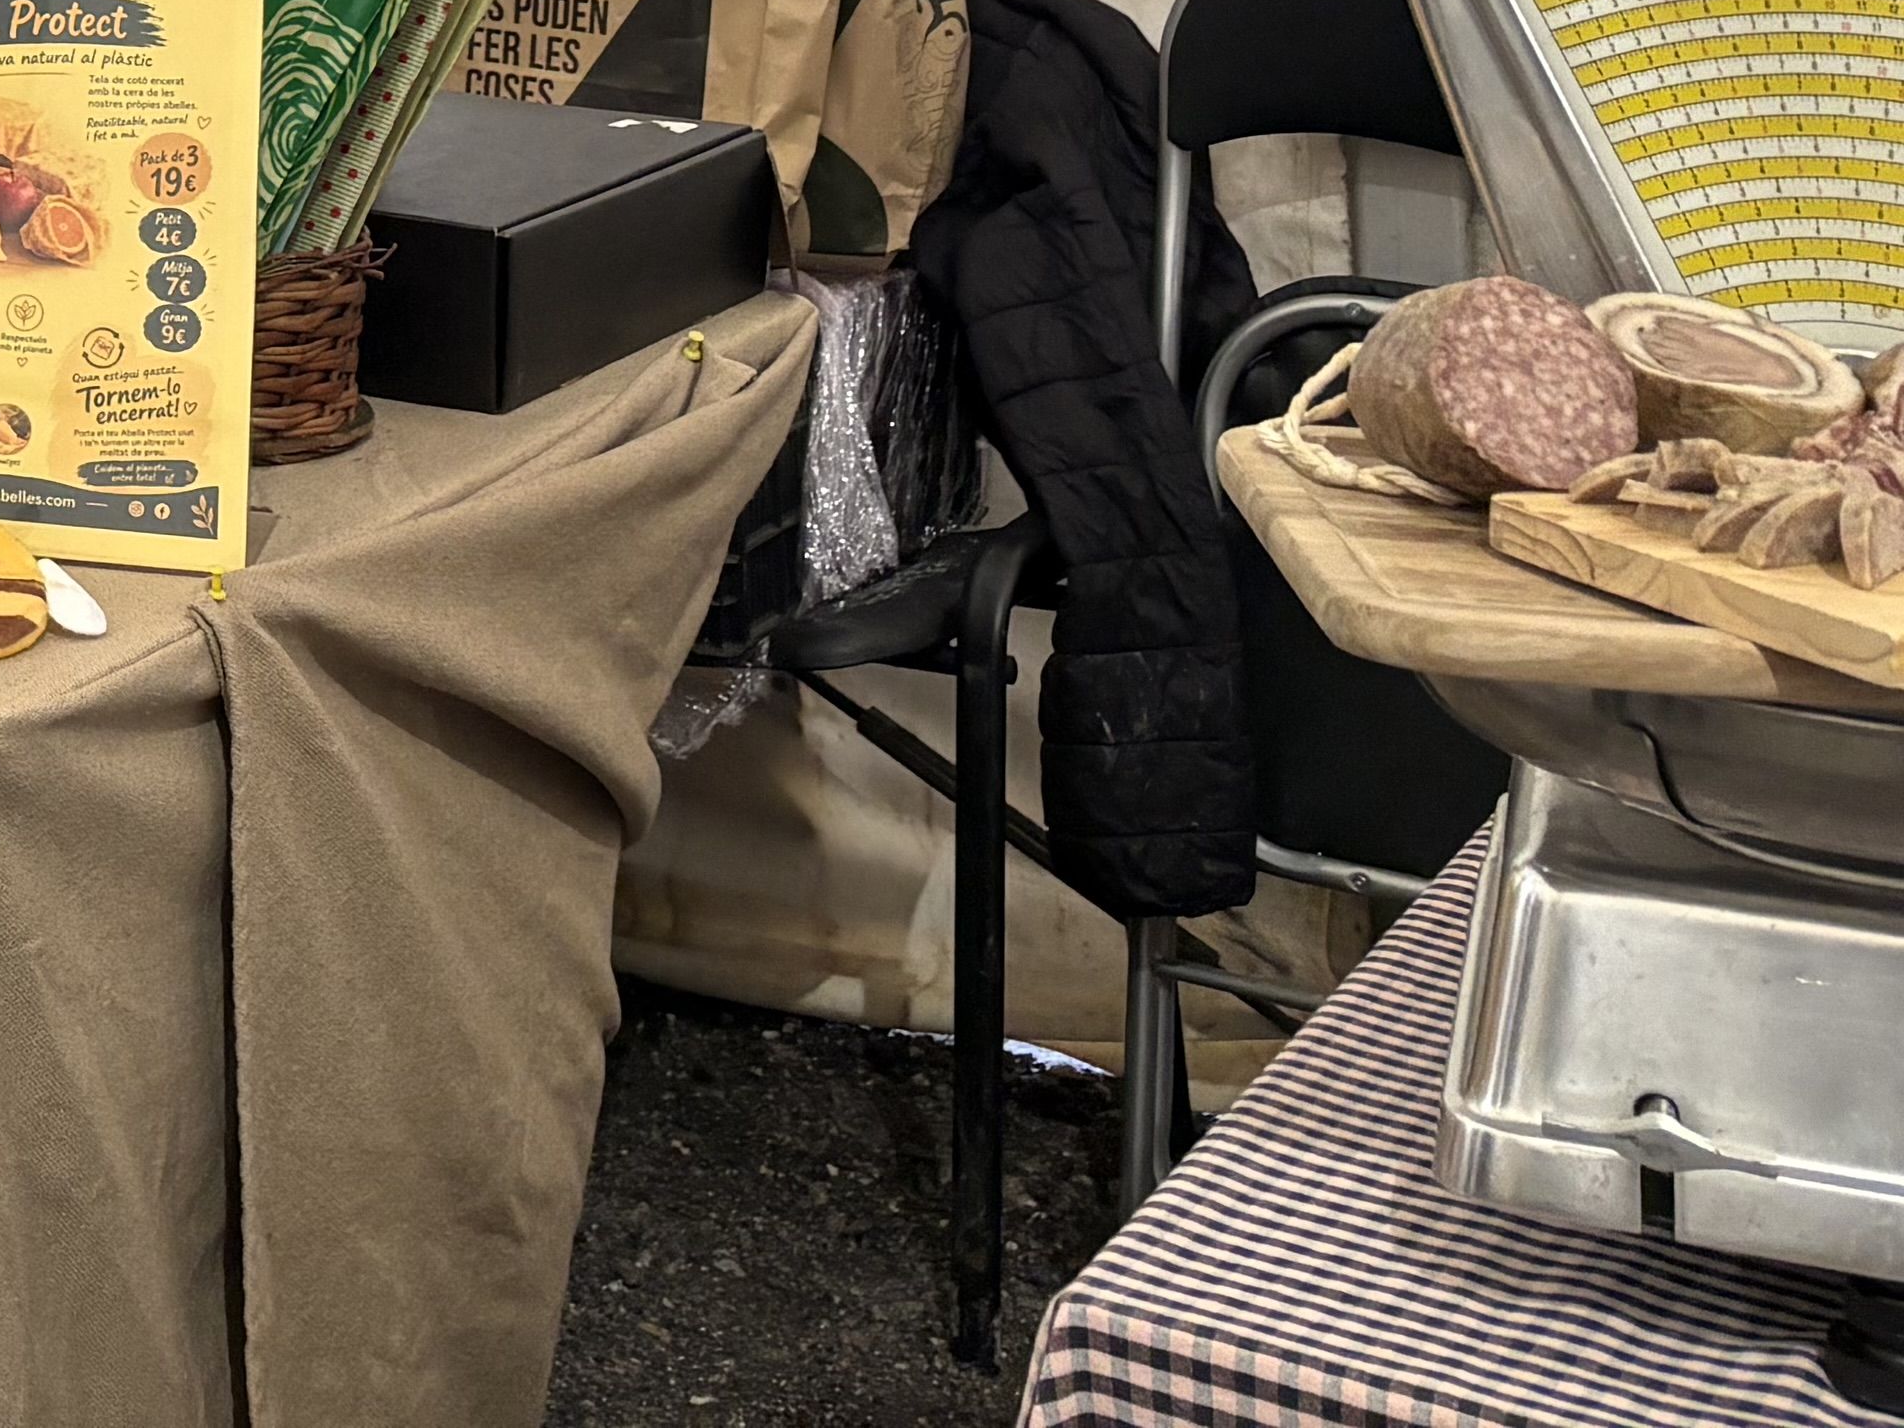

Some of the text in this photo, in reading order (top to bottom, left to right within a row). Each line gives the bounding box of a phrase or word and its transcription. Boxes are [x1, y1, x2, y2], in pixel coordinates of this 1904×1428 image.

[9, 0, 127, 39] Protect
[21, 49, 75, 64] natural
[81, 49, 96, 64] al
[101, 52, 153, 69] plàstic
[468, 27, 580, 74] FER LES
[89, 75, 108, 83] Tela
[162, 89, 174, 97] les
[152, 114, 188, 124] natural
[94, 130, 106, 142] fet
[140, 145, 199, 167] Pack de 3
[151, 166, 196, 197] 19€
[155, 213, 181, 225] Petit
[155, 228, 181, 245] 4€
[161, 262, 192, 276] Mitja
[166, 277, 190, 296] 7€
[160, 310, 188, 323] Gran
[161, 326, 186, 344] 9€
[72, 373, 100, 383] Quan
[104, 369, 139, 382] estigui
[76, 377, 181, 413] Tornem-lo
[96, 398, 180, 424] encerrat!
